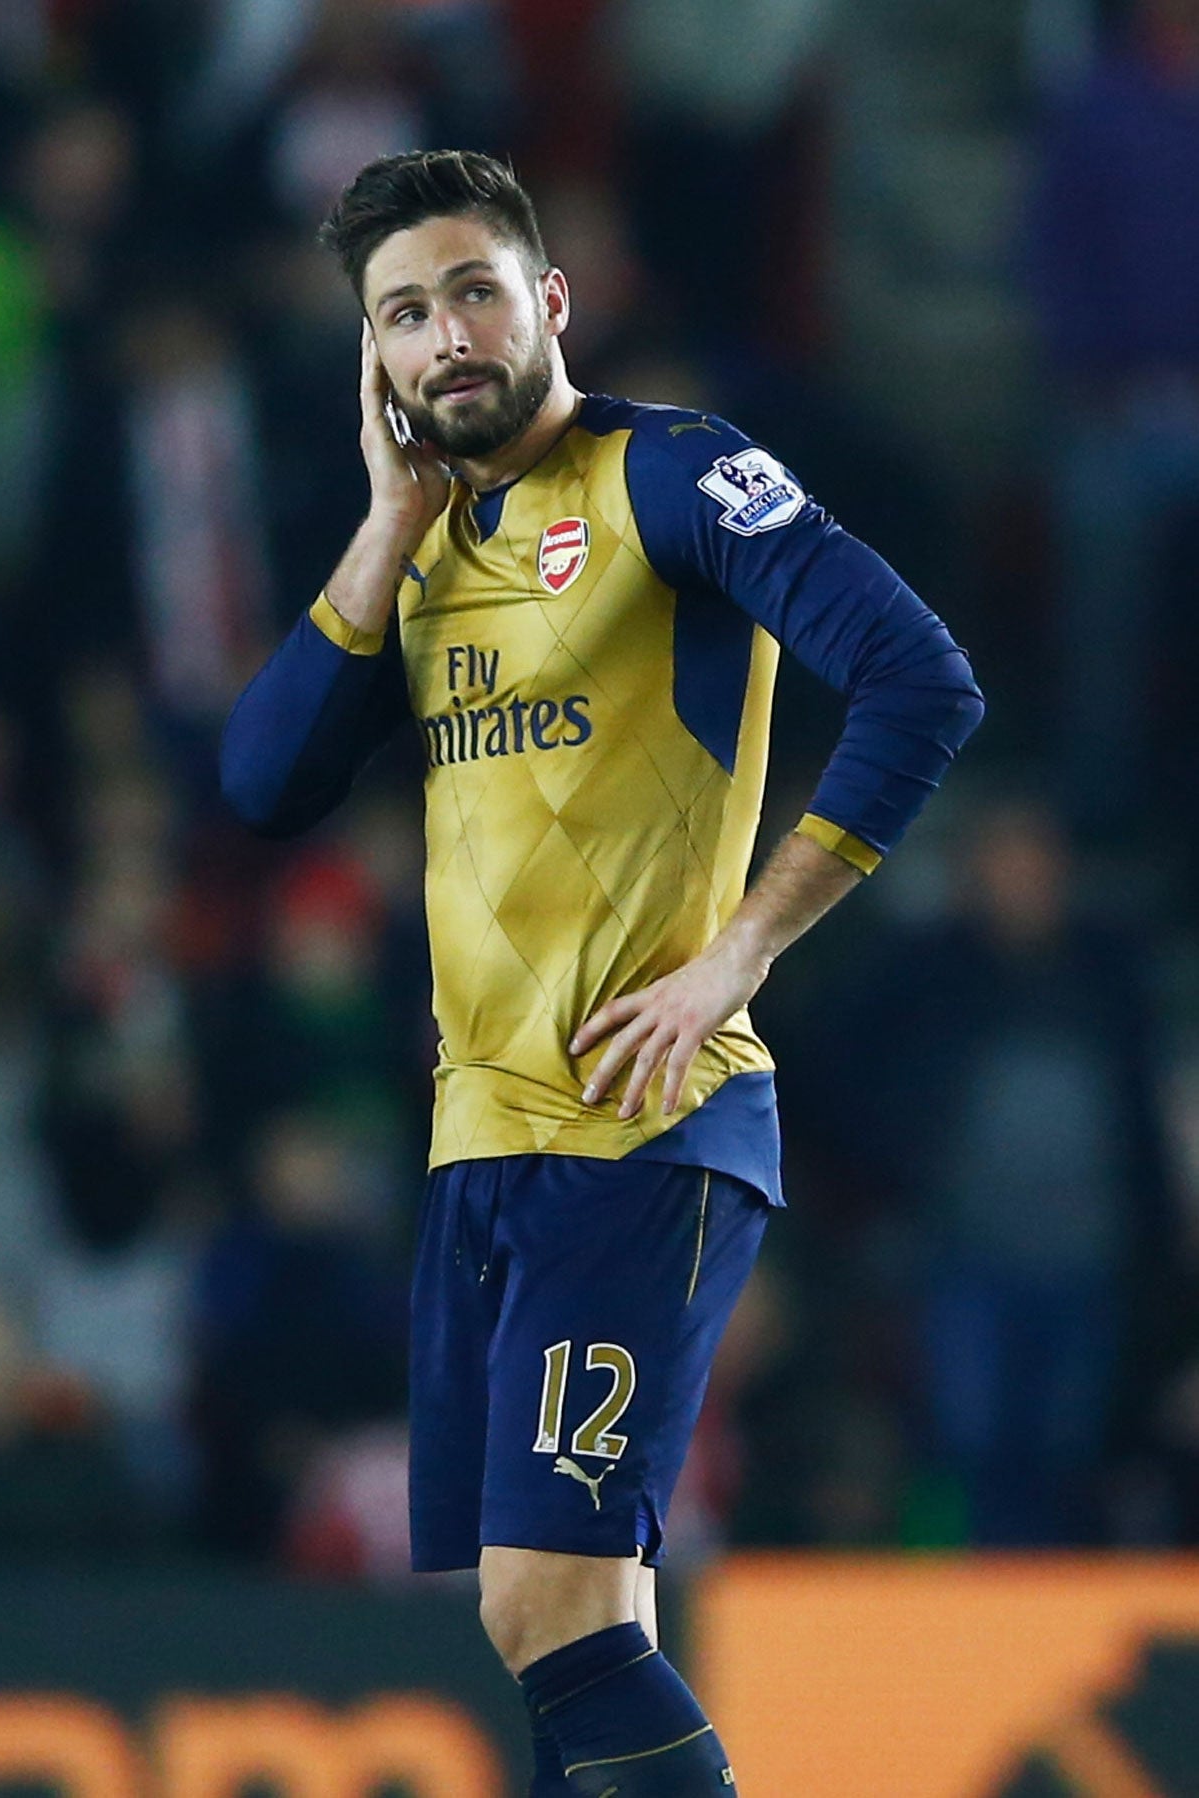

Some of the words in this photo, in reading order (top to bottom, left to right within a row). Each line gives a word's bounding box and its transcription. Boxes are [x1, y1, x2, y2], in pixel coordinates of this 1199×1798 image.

[446, 644, 499, 695] Fly
[421, 691, 592, 768] mirates
[532, 1340, 637, 1460] 12
